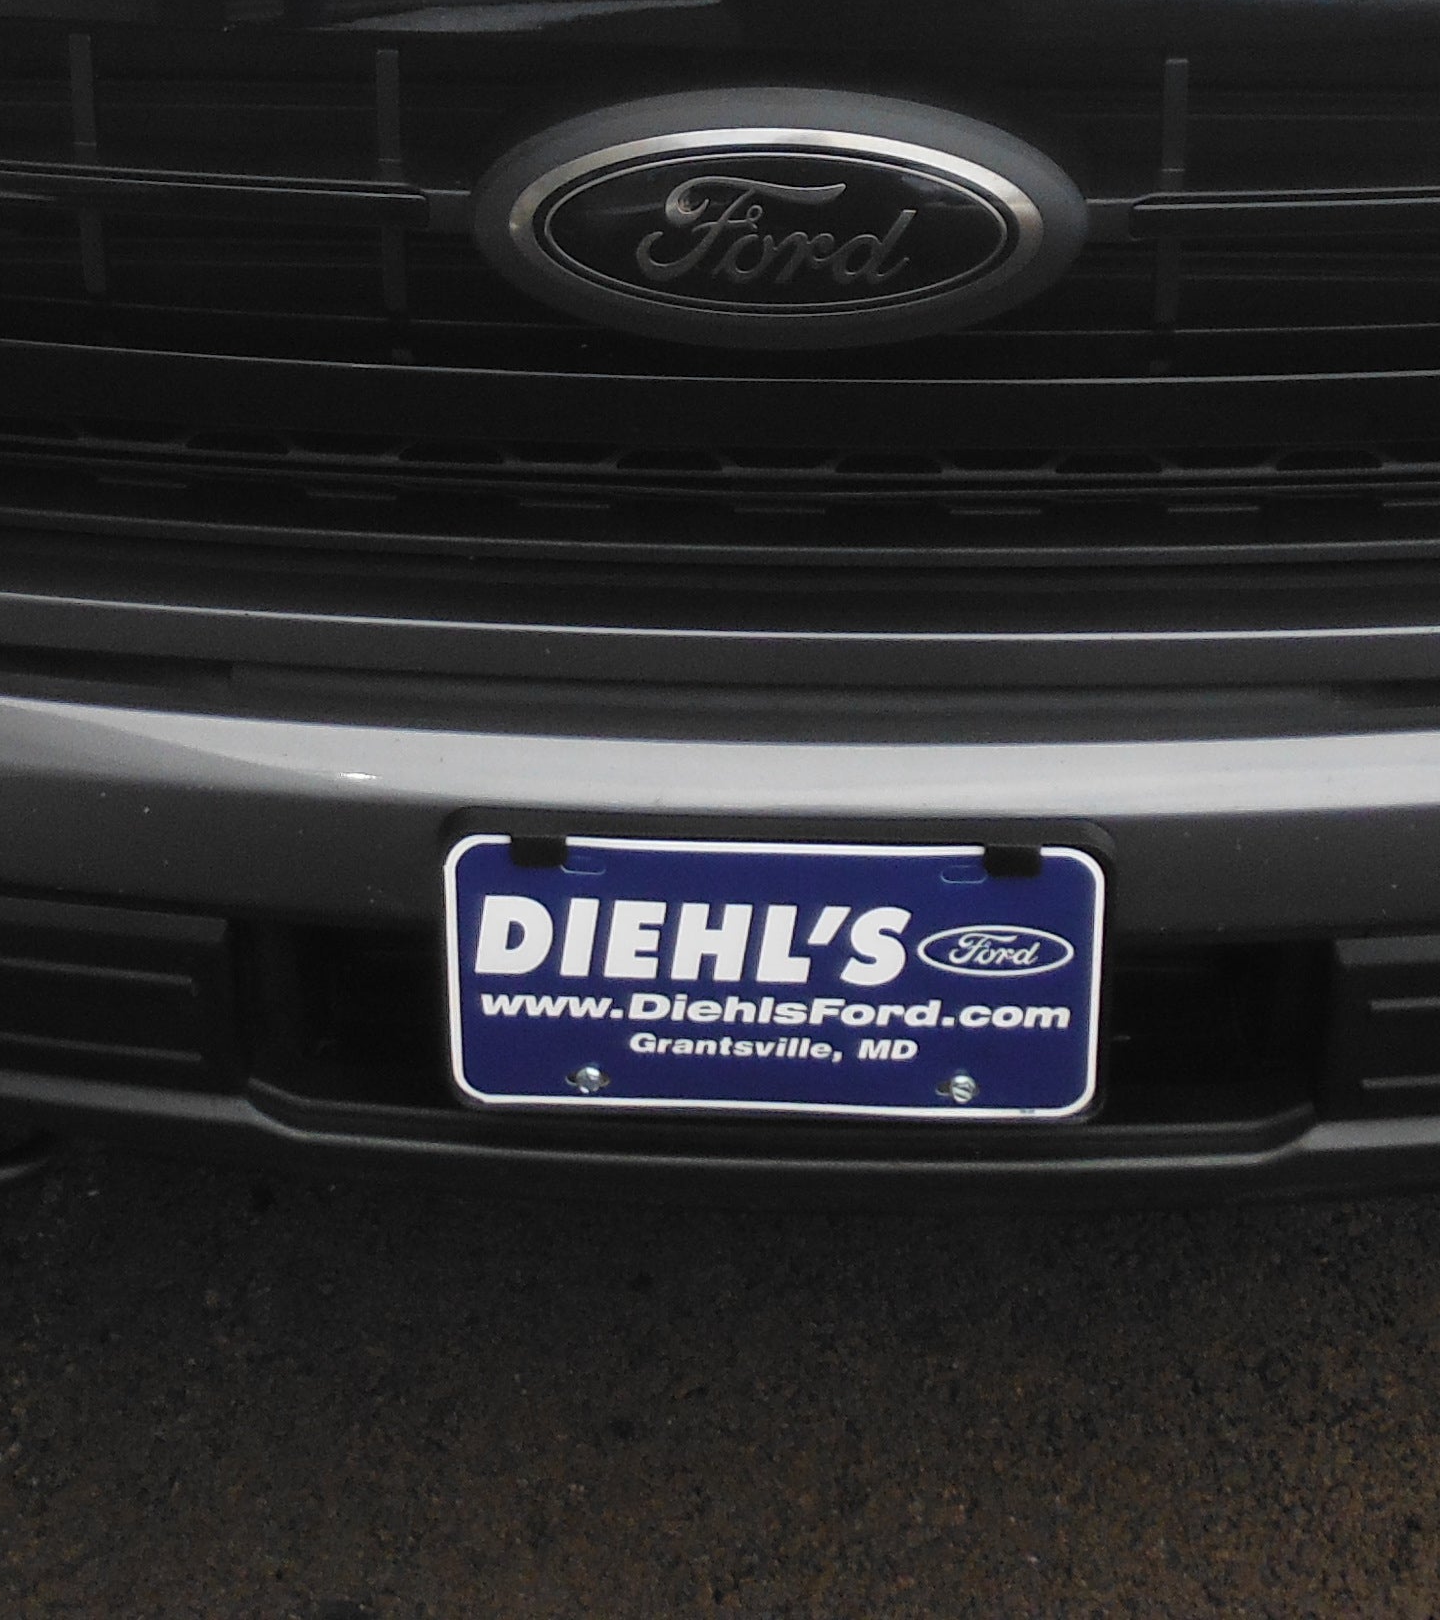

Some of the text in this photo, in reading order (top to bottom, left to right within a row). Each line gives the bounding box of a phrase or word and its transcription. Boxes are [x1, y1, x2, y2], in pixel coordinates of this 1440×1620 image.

[635, 175, 918, 285] Ford
[474, 894, 912, 987] DIEHL'S
[949, 931, 1040, 970] Ford
[480, 992, 1071, 1029] www.DiehlsFord.com
[629, 1032, 918, 1062] Grantsville, MD
